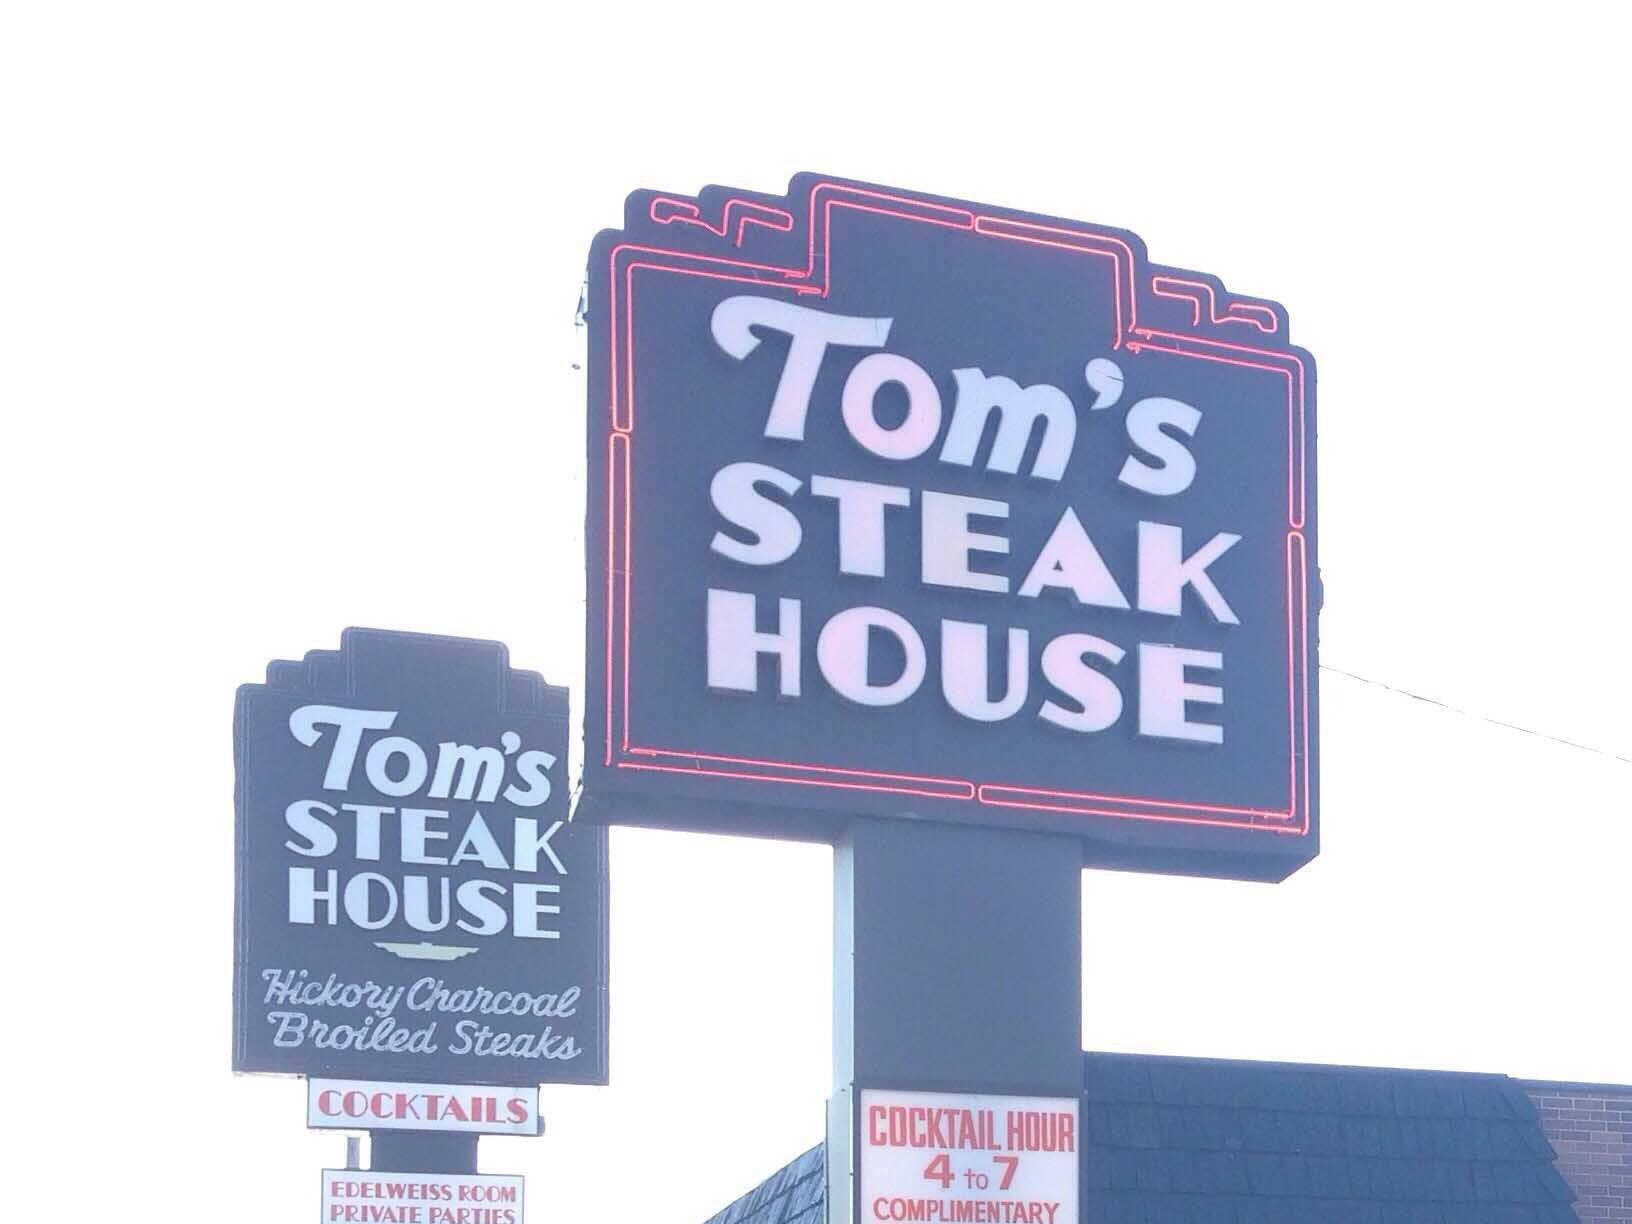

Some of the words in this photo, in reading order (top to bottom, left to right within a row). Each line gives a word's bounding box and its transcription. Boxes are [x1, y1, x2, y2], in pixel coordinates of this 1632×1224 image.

[710, 295, 1203, 497] Tom's
[709, 461, 1242, 626] STEAK
[706, 588, 1224, 745] HOUSE
[288, 704, 557, 807] Tom's
[284, 799, 568, 875] STEAK
[288, 866, 561, 940] HOUSE
[262, 968, 404, 1018] Hickory
[407, 976, 582, 1018] Charcoal
[267, 1010, 438, 1054] Broiled
[448, 1019, 583, 1060] Steaks
[317, 1089, 529, 1125] COCKTAILS
[867, 1104, 1002, 1151] COCKTAIL
[1006, 1110, 1076, 1153] HOUR
[331, 1181, 453, 1201] EDELWEISS
[458, 1184, 517, 1203] ROOM
[923, 1153, 955, 1189] 4
[963, 1168, 989, 1190] to
[992, 1155, 1020, 1191] 7
[330, 1204, 423, 1224] PRIVATE
[872, 1196, 1061, 1224] COMPLIMENTARY
